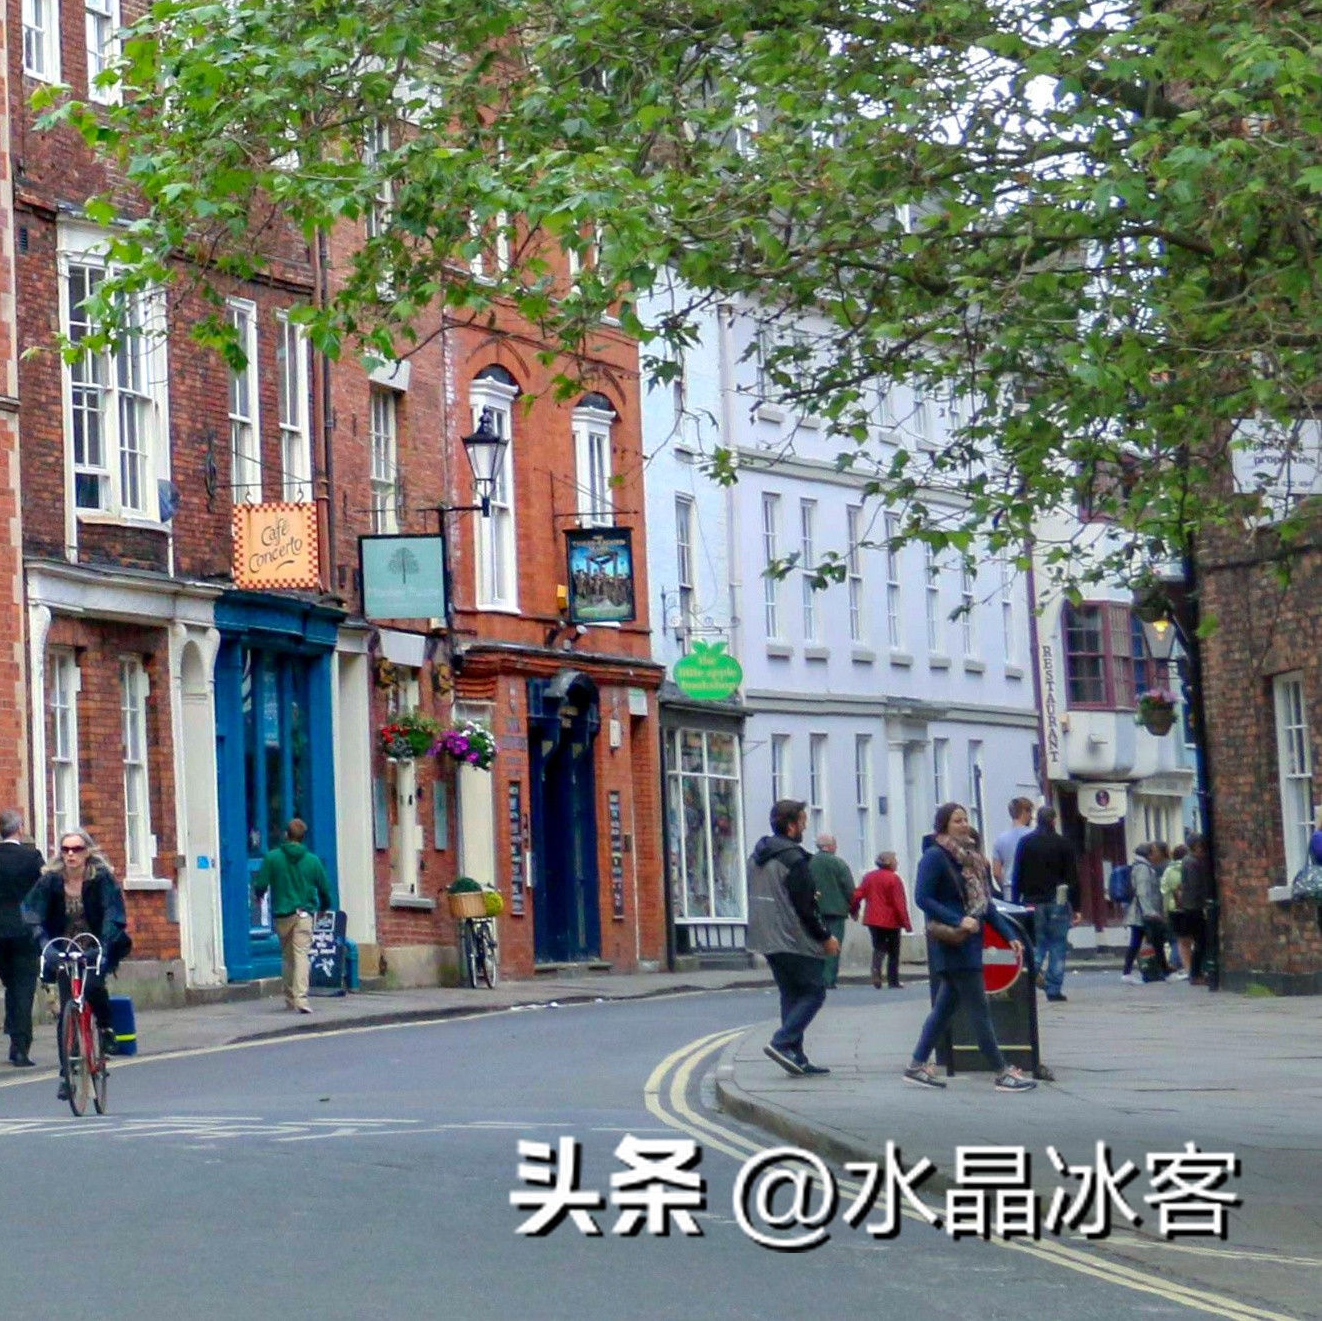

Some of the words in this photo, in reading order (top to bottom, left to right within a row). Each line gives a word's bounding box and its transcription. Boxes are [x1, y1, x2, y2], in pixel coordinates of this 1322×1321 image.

[261, 517, 290, 546] Café
[248, 537, 303, 574] Concerto
[1042, 646, 1058, 762] RESTAURANT
